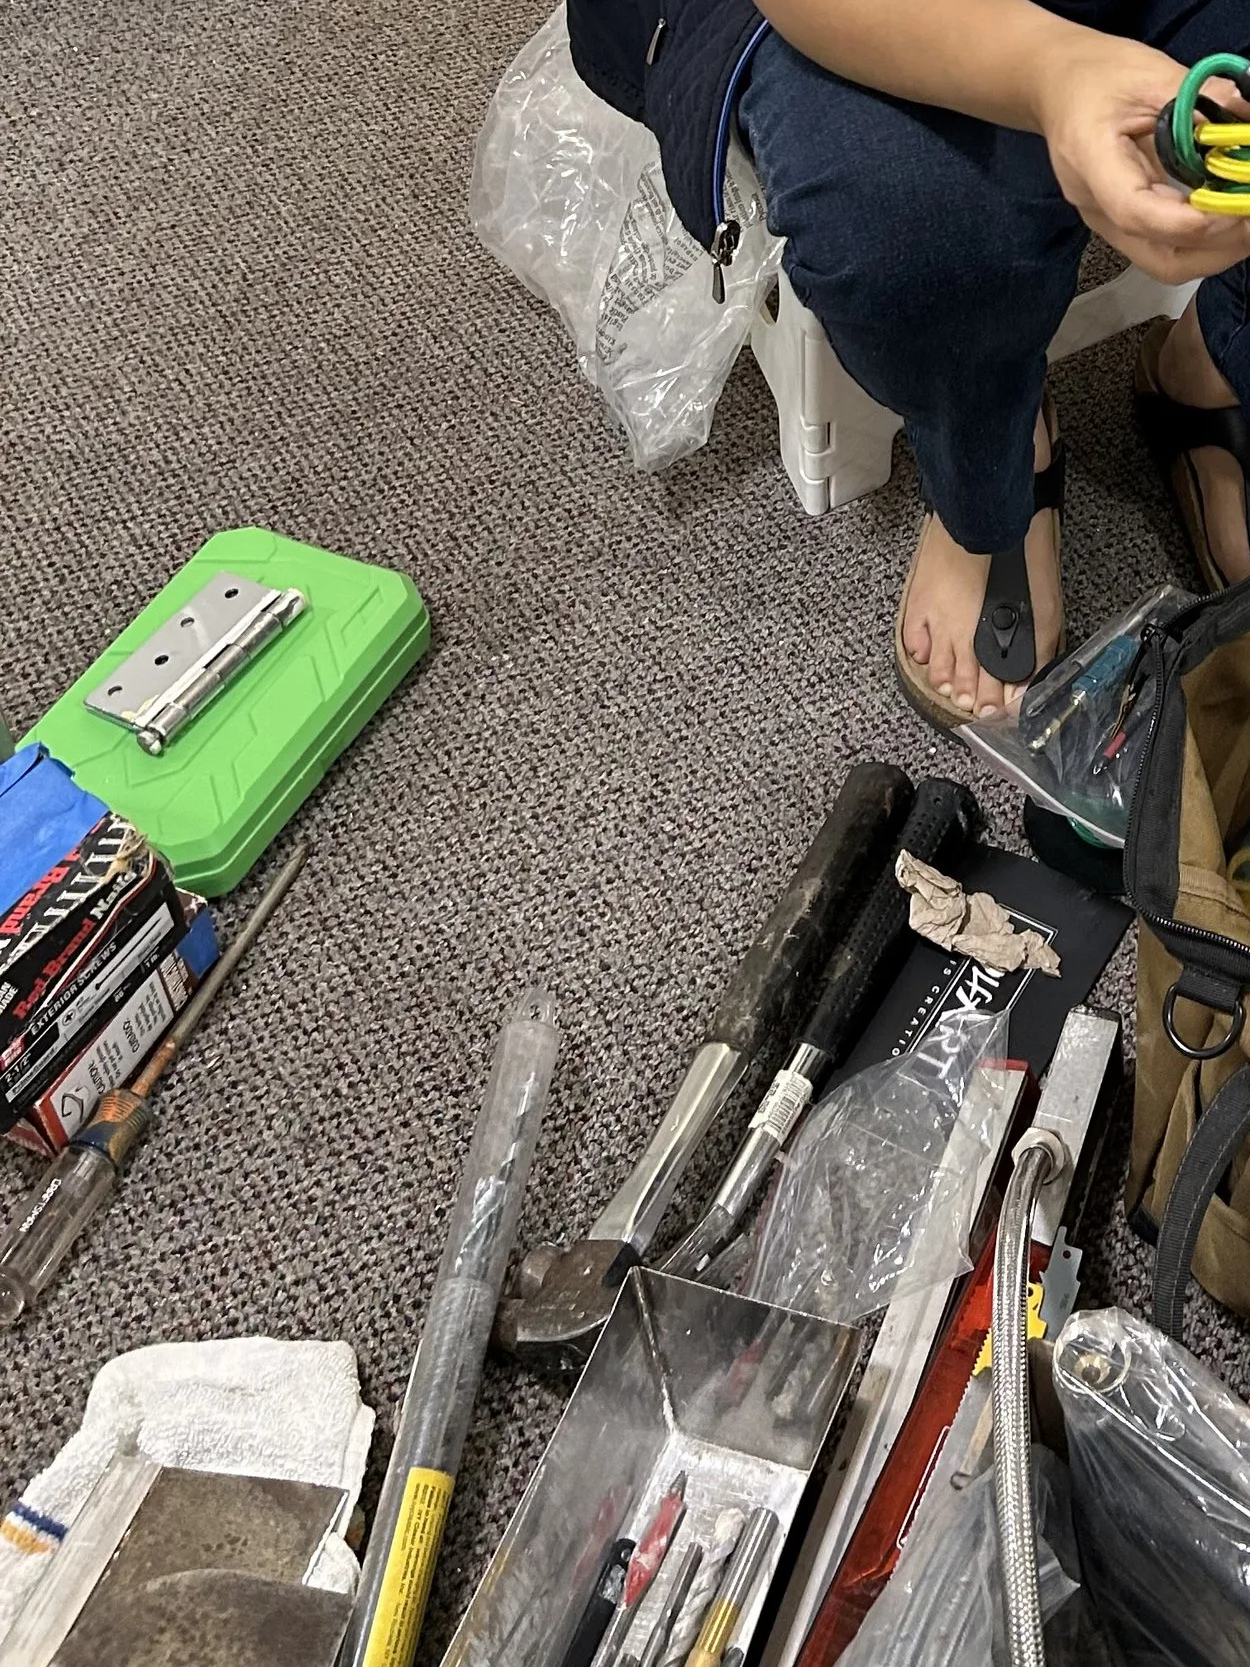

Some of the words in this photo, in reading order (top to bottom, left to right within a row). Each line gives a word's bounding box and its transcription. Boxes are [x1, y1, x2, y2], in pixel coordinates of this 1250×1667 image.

[13, 977, 48, 1020] Red
[43, 917, 98, 978] Brand
[30, 985, 80, 1036] EXTERIOR
[76, 940, 118, 988] SCREWS
[19, 1178, 62, 1233] CRAFTSMAN
